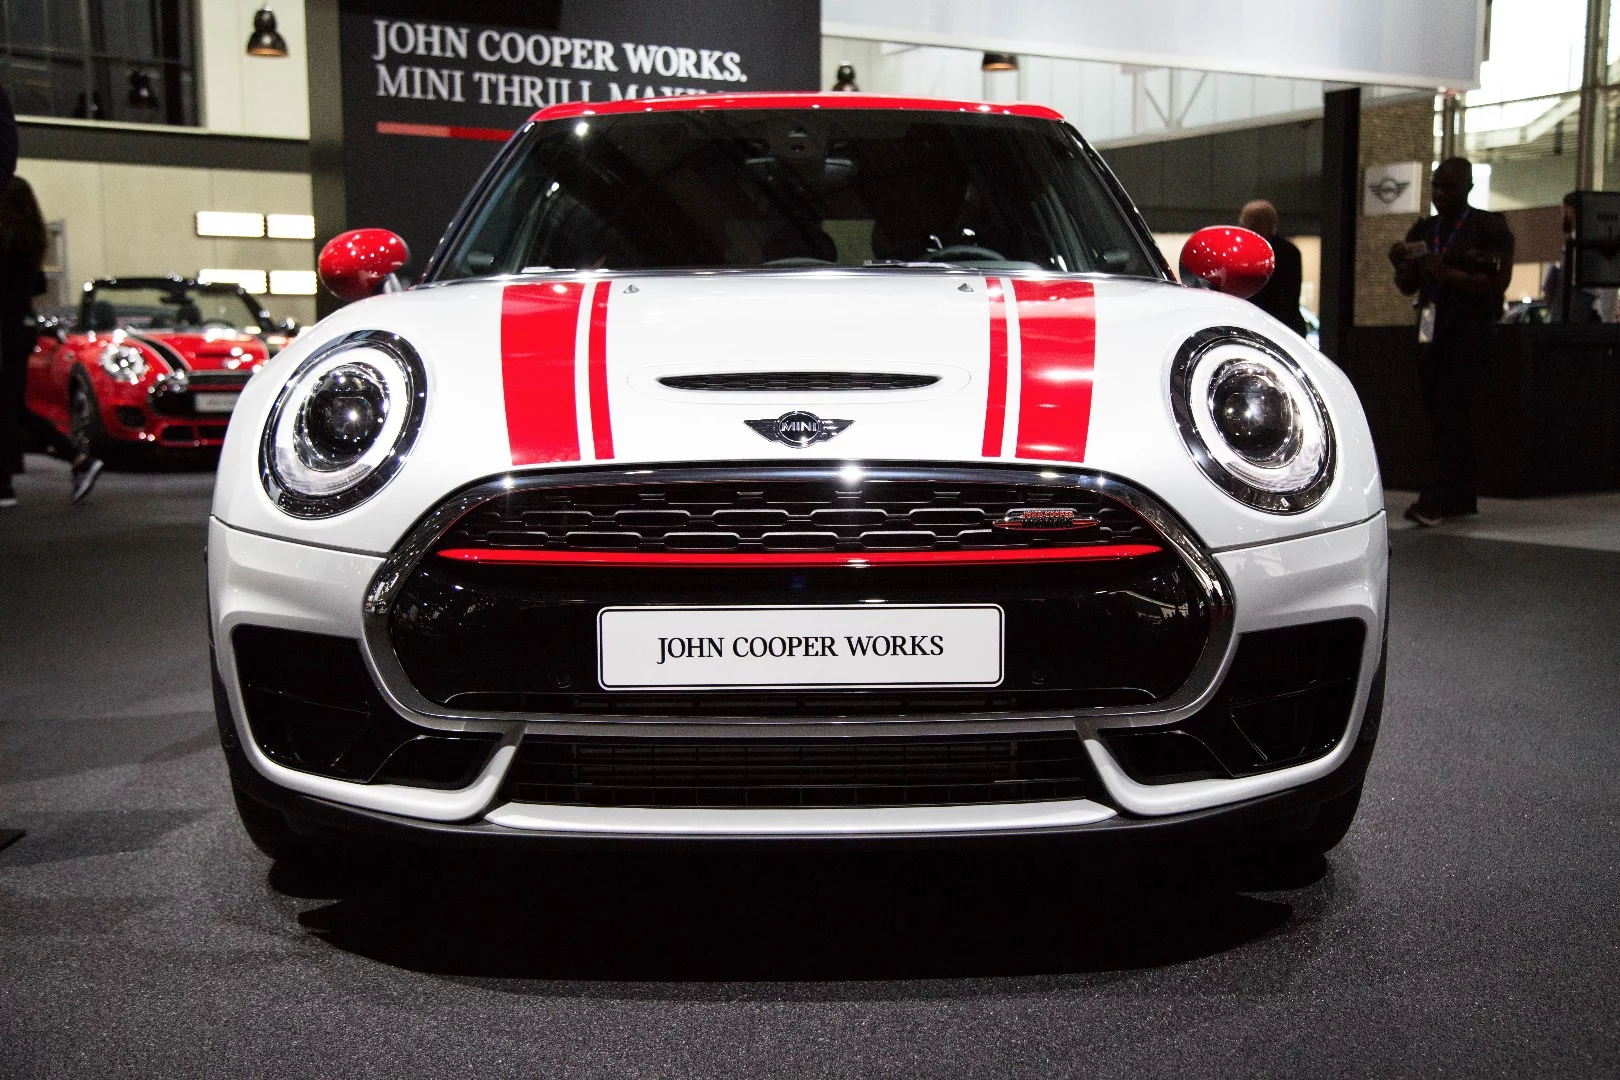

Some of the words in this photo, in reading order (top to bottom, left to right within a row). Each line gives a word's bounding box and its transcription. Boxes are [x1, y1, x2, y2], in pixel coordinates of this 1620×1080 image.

[373, 20, 469, 61] JOHN
[478, 29, 619, 73] COOPER
[621, 42, 749, 83] WORKS.
[375, 64, 464, 101] MINI
[781, 421, 817, 432] MINI
[656, 637, 725, 665] JOHN
[732, 636, 838, 658] COOPER
[844, 635, 944, 657] WORKS
